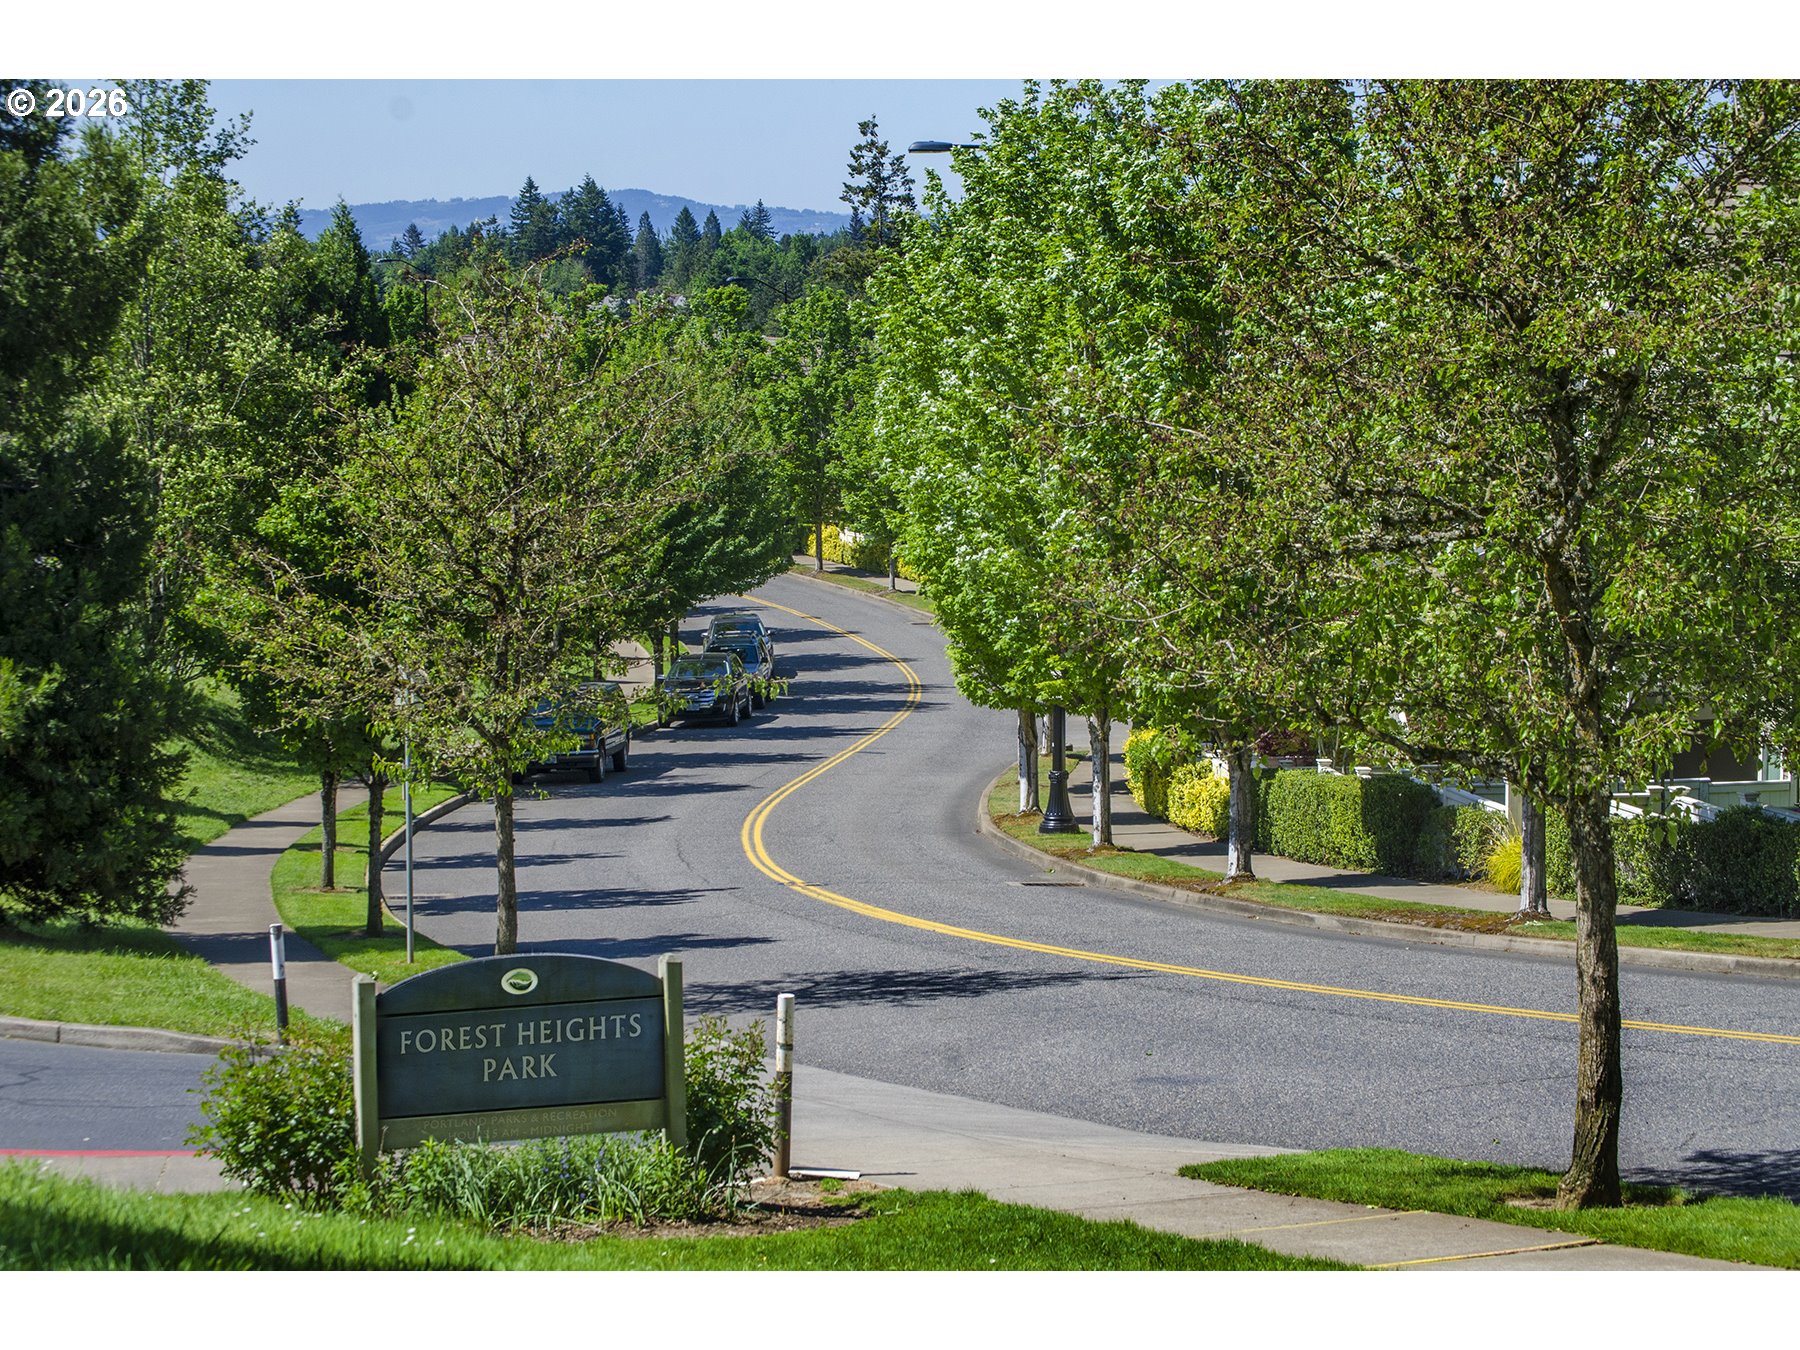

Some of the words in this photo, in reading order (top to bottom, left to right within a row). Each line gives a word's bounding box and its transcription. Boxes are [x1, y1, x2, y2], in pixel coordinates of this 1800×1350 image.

[400, 1022, 506, 1055] FOREST
[518, 1013, 642, 1046] HEIGHTS
[483, 1053, 558, 1082] PARK
[423, 1116, 487, 1130] PORTLAND
[491, 1113, 528, 1125] PARKS
[542, 1108, 617, 1122] RECREATION
[448, 1129, 490, 1141] HOU
[502, 1127, 519, 1138] AM
[530, 1122, 592, 1136] MIDNIGHT
